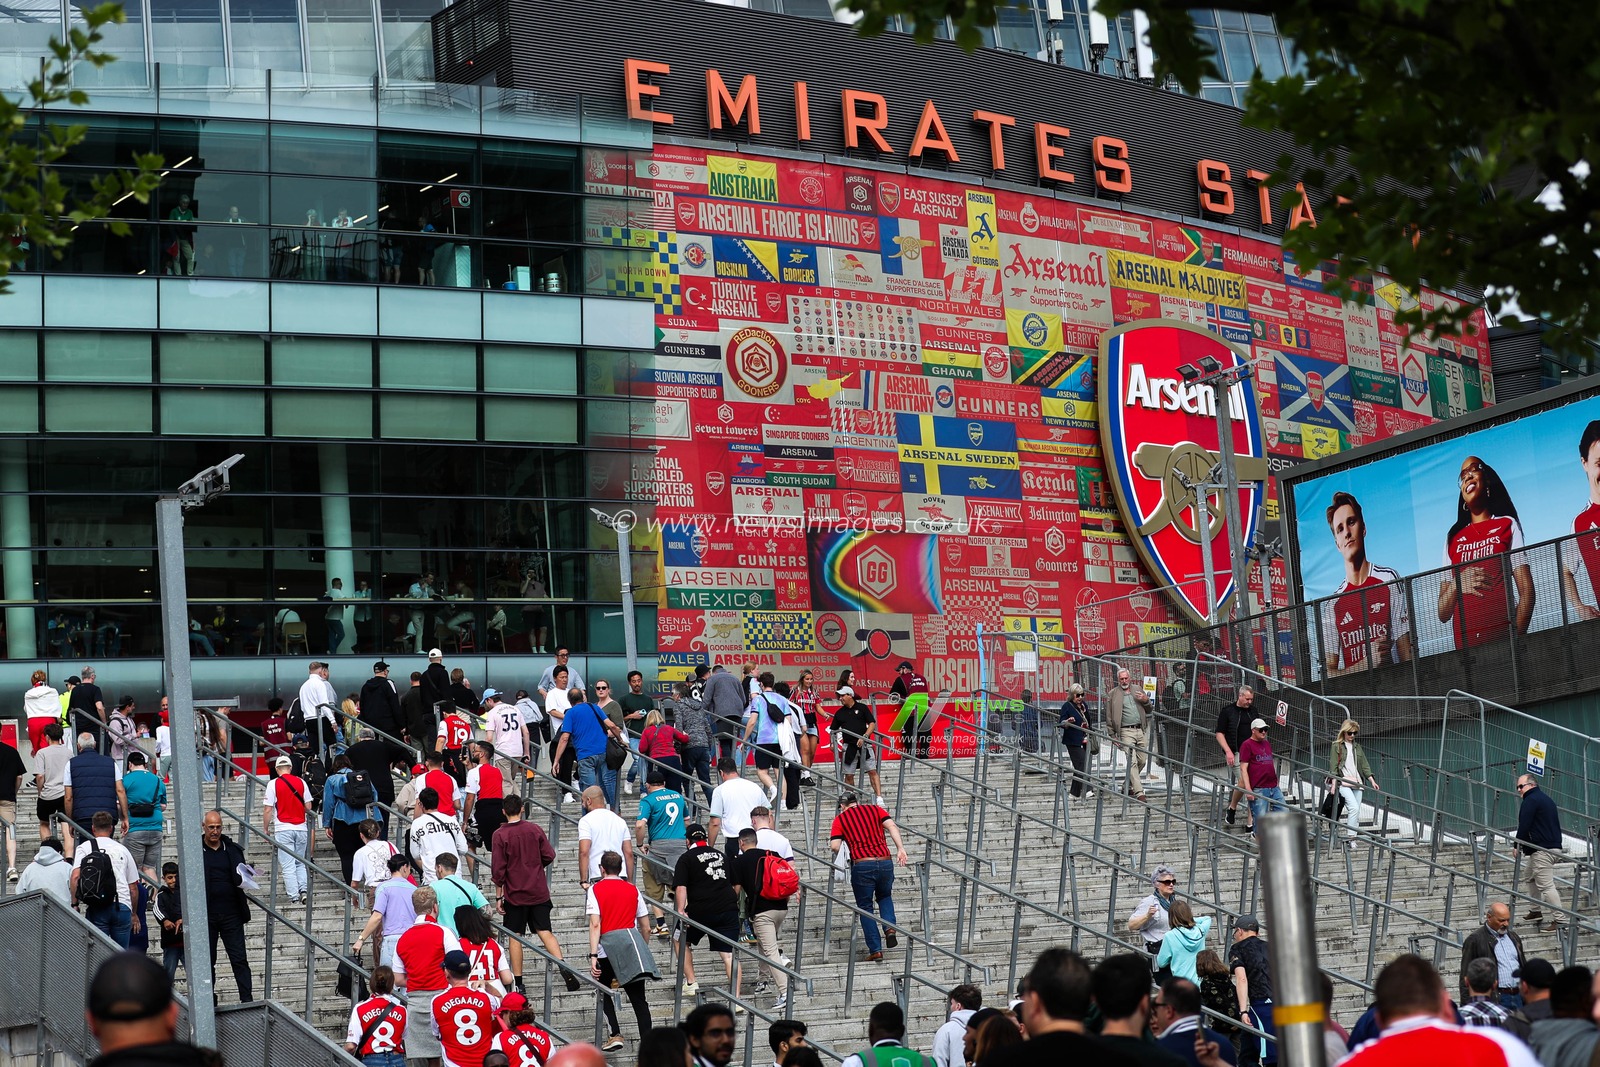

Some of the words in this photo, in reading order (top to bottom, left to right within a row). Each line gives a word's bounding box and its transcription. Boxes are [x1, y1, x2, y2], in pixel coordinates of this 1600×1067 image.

[623, 58, 1133, 193] EMIRATES
[709, 171, 778, 200] AUSTRALIA
[845, 176, 874, 188] ARSENAL
[903, 188, 929, 203] EAST
[928, 191, 964, 208] SUSSEX
[967, 192, 994, 205] ARSENAL
[850, 203, 872, 212] QATAR
[912, 202, 958, 220] ARSENAL
[698, 201, 760, 235] ARSENAL
[761, 208, 804, 239] FAROE
[805, 213, 860, 246] ISLANDS
[997, 208, 1019, 222] ARSENAL
[1040, 214, 1077, 232] PHILADELPHIA
[942, 236, 969, 249] ARSENAL
[1162, 233, 1178, 243] ARSENAL
[942, 246, 970, 260] CANADA
[1156, 239, 1170, 250] CAPE
[1170, 242, 1186, 254] TOWN
[1004, 243, 1107, 288] Arsenal
[1222, 247, 1269, 270] FERMANAGH
[644, 268, 667, 278] DOWN
[783, 267, 816, 284] GOONERS
[1116, 258, 1176, 288] ARSENAL
[1178, 270, 1241, 300] MALDIVES
[710, 278, 757, 302] TÜRKİYE
[886, 276, 912, 287] FRANCE
[913, 280, 941, 290] D'ALSACE
[886, 284, 924, 296] SUPPORTERS
[925, 288, 944, 297] CLUB
[1033, 286, 1058, 298] Armed
[1059, 288, 1084, 300] Forces
[711, 299, 761, 318] ARSENAL
[918, 299, 959, 313] NORTH
[962, 304, 1003, 318] WALES
[1030, 296, 1071, 310] Supporters
[1072, 300, 1088, 312] Club
[1160, 296, 1188, 307] ARSENAL
[1188, 300, 1206, 310] DELHI
[668, 318, 698, 328] SUDAN
[1324, 318, 1344, 329] CENTRAL
[936, 328, 993, 342] GUNNERS
[1067, 331, 1092, 346] DERRY
[1224, 328, 1249, 343] Iceland
[664, 345, 706, 356] GUNNERS
[924, 339, 978, 353] ARSENAL
[1348, 344, 1380, 358] YORKSHIRE
[654, 370, 687, 384] SLOVENIA
[687, 372, 718, 386] ARSENAL
[931, 366, 974, 379] GHANA
[1428, 358, 1480, 388] ARSENAL
[656, 384, 700, 398] SUPPORTERS
[700, 386, 718, 399] CLUB
[737, 380, 781, 398] GOONERS
[886, 375, 932, 396] ARSENAL
[1126, 363, 1246, 421] Arsenl
[1281, 382, 1303, 394] ARSENAL
[1328, 391, 1352, 402] SCOTLAND
[796, 396, 811, 404] COYG
[1056, 390, 1081, 400] ARSENAL
[883, 392, 935, 414] BRITTANY
[958, 396, 1040, 417] GUNNERS
[694, 422, 722, 436] seven
[725, 424, 759, 436] towers
[1045, 417, 1066, 426] NEWRY
[1072, 420, 1096, 430] MOURNE
[765, 430, 800, 441] SINGAPORE
[800, 431, 830, 442] GOONERS
[834, 435, 896, 450] ARGENTINA
[731, 444, 761, 452] ARSENAL
[780, 448, 818, 458] ARSENAL
[1024, 442, 1041, 450] RWANDA
[1041, 444, 1059, 452] ARSENAL
[1058, 445, 1084, 454] SUPPORTERS
[902, 448, 963, 462] ARSENAL
[965, 454, 1016, 468] SWEDEN
[731, 477, 766, 485] CAMBODIA
[772, 474, 802, 485] SOUTH
[802, 476, 830, 486] SUDAN
[854, 468, 900, 484] MANCHESTER
[1022, 470, 1076, 493] Kerala
[623, 480, 694, 496] SUPPORTERS
[734, 486, 800, 498] ARSENAL
[746, 502, 756, 510] AFC
[814, 494, 831, 508] NEW
[922, 496, 946, 505] DOVER
[1028, 504, 1078, 524] Islington
[736, 527, 769, 538] HONG
[773, 528, 804, 539] KONG
[668, 541, 686, 550] ARSENAL
[710, 542, 734, 552] PHILIPPINES
[940, 536, 955, 544] Cork
[956, 537, 968, 545] City
[968, 536, 996, 546] NORFOLK
[998, 538, 1027, 548] ARSENAL
[1456, 535, 1502, 554] Emirates
[737, 554, 807, 567] GUNNERS
[1461, 550, 1472, 563] FLY
[943, 566, 967, 574] Gooners
[1035, 557, 1079, 573] Gooners
[1106, 560, 1135, 568] ARSENAL
[670, 570, 770, 587] ARSENAL
[775, 570, 808, 581] WOOLWICH
[866, 560, 888, 583] GG
[970, 566, 1011, 577] SUPPORTERS
[1012, 569, 1029, 578] CLUB
[778, 586, 786, 596] 18
[798, 586, 808, 596] 86
[944, 578, 999, 592] ARSENAL
[778, 600, 810, 610] Arsenal
[709, 610, 737, 618] OMAGH
[754, 613, 801, 623] HACKNEY
[1340, 621, 1388, 649] Emiates
[709, 644, 743, 652] GOONERS
[755, 640, 803, 650] GOONERS
[951, 638, 1003, 653] CROTA
[658, 654, 706, 665] WALES
[714, 654, 778, 666] ARSENAL
[794, 654, 840, 664] GUNNERS
[825, 669, 836, 678] 86
[854, 678, 893, 688] ARSENAL
[501, 713, 520, 732] 35
[454, 726, 470, 746] 19
[665, 802, 680, 826] 9
[469, 949, 496, 980] 41
[440, 996, 484, 1014] ØDEGAARD
[453, 1008, 483, 1046] 8
[370, 1020, 397, 1054] 8
[518, 1044, 541, 1067] 8
